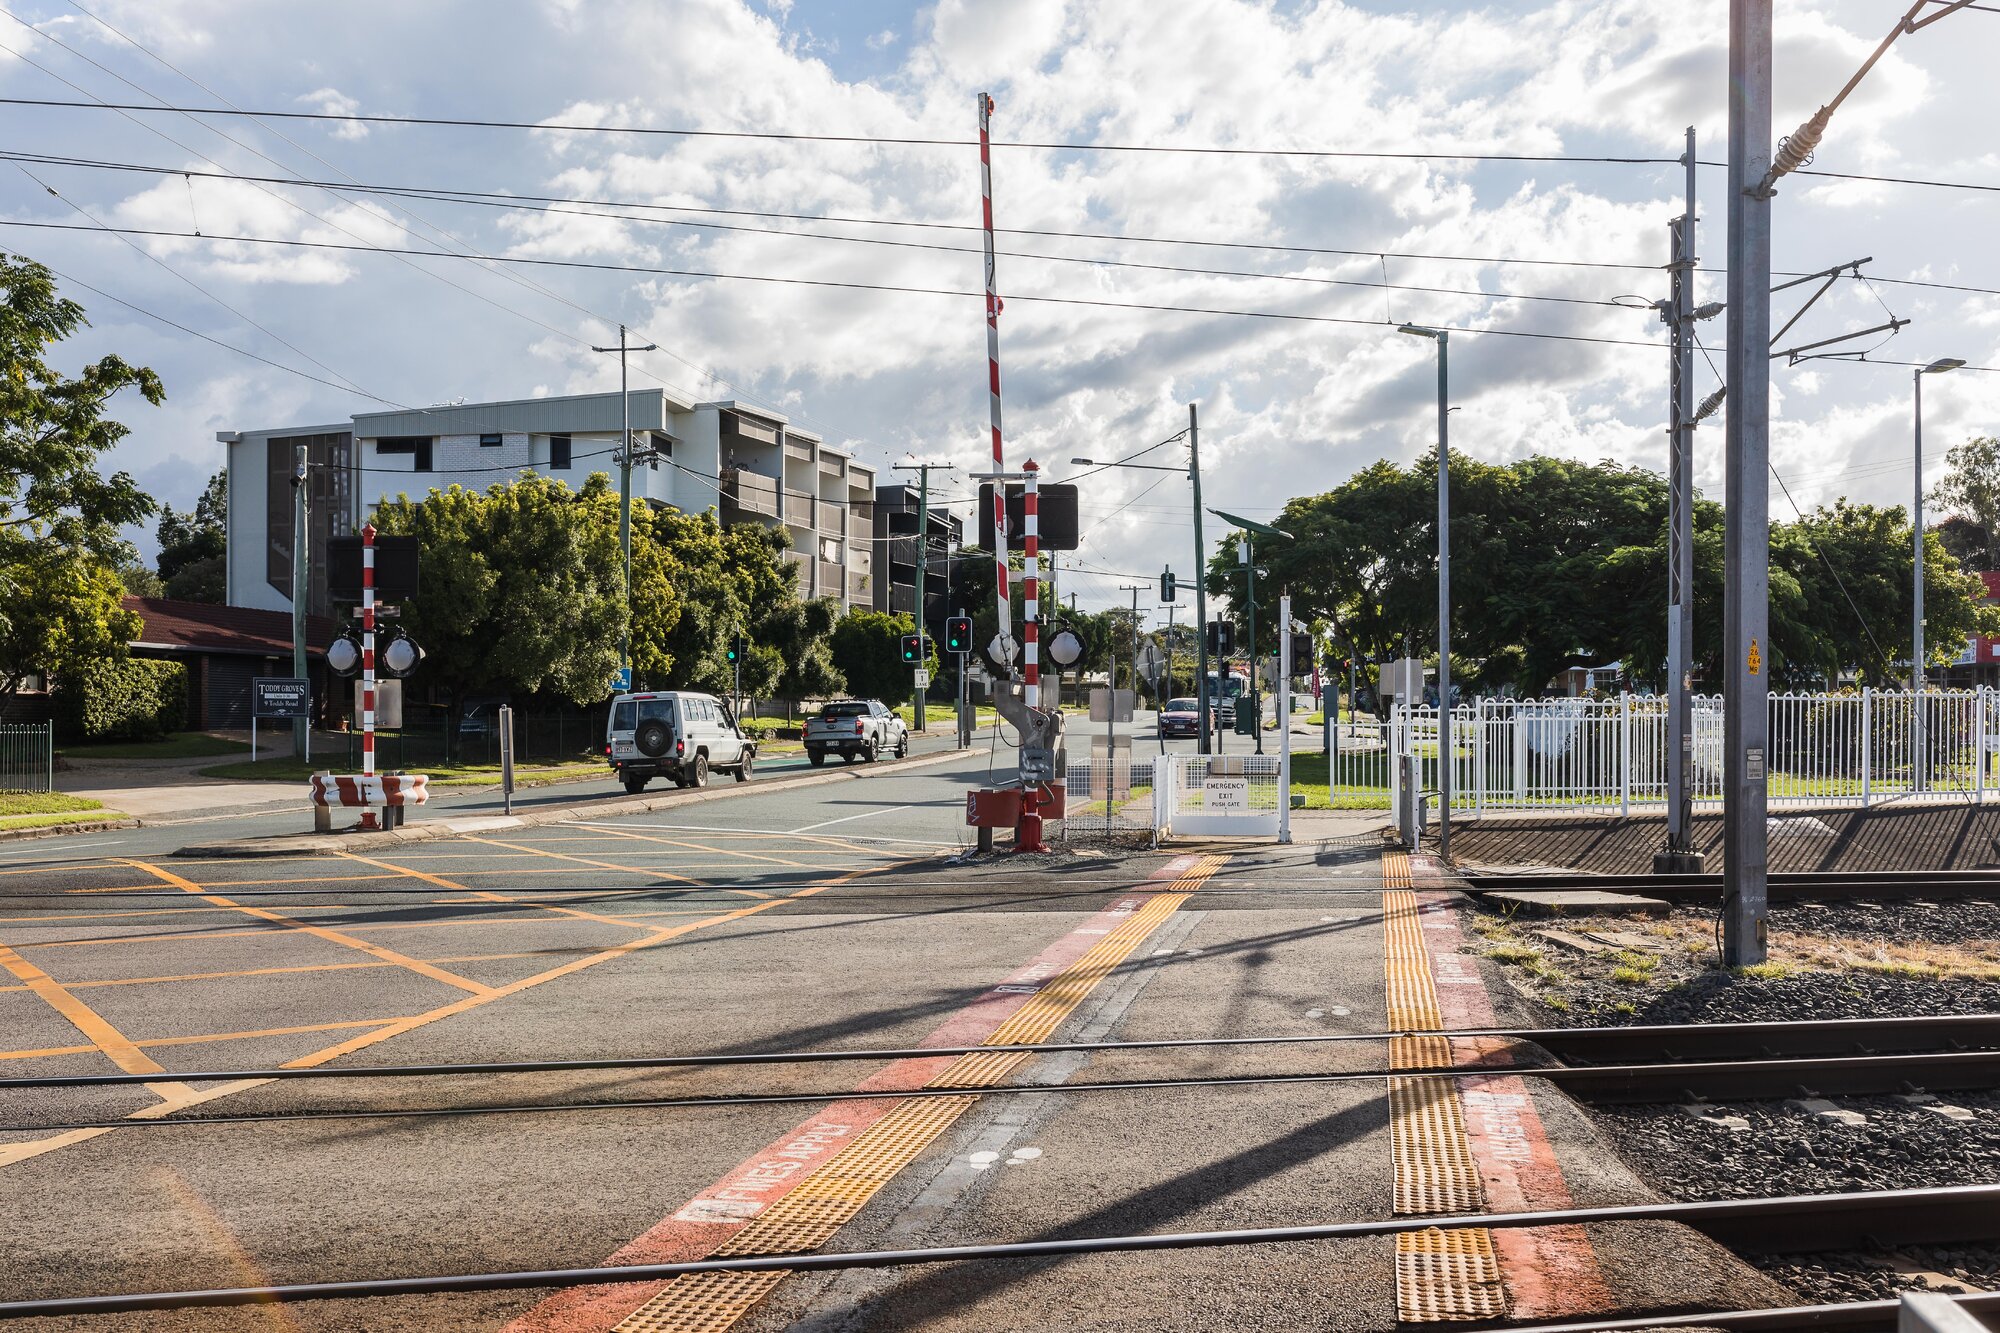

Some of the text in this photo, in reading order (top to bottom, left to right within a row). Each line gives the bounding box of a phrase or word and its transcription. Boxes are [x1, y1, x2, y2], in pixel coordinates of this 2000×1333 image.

[1748, 657, 1761, 665] 764
[258, 684, 305, 696] TODDY GROVES
[1218, 792, 1233, 800] EXIT
[1484, 1124, 1537, 1164] ENTRY
[716, 1122, 853, 1201] FINES APPLY
